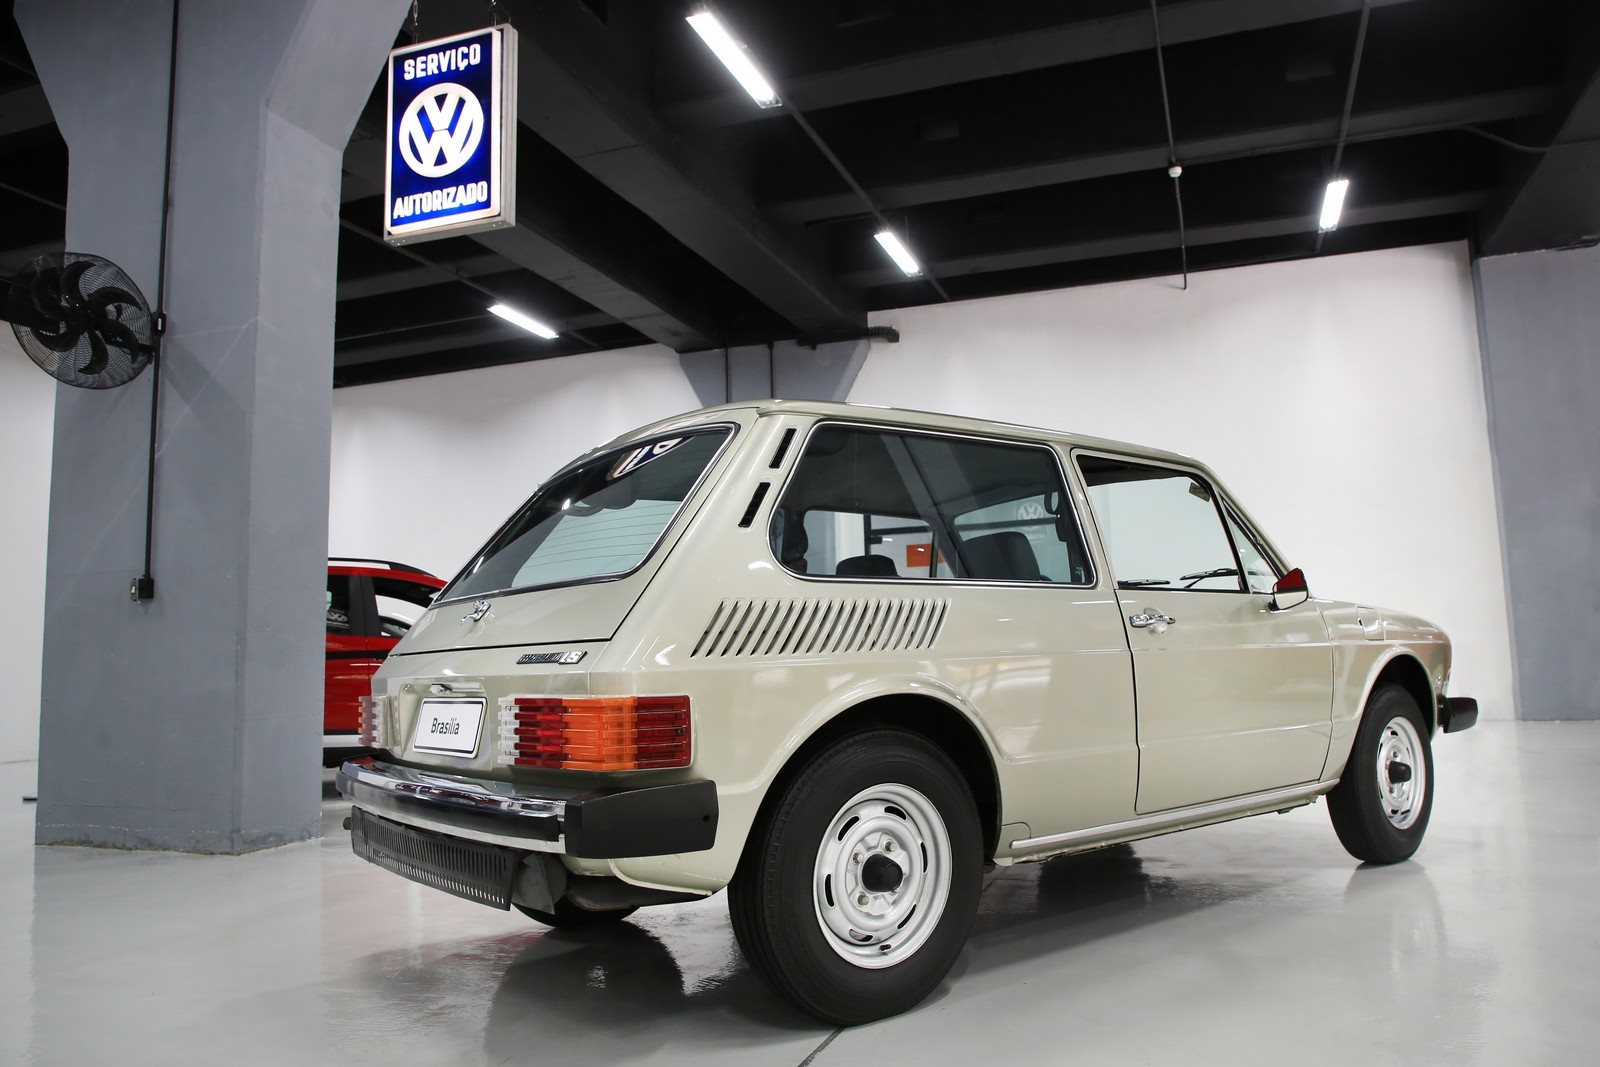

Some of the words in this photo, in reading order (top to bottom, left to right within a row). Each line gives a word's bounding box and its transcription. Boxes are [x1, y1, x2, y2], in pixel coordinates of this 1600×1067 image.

[404, 44, 481, 80] SERVIÇO
[402, 85, 481, 174] VW
[393, 181, 488, 219] AUTORIZADO
